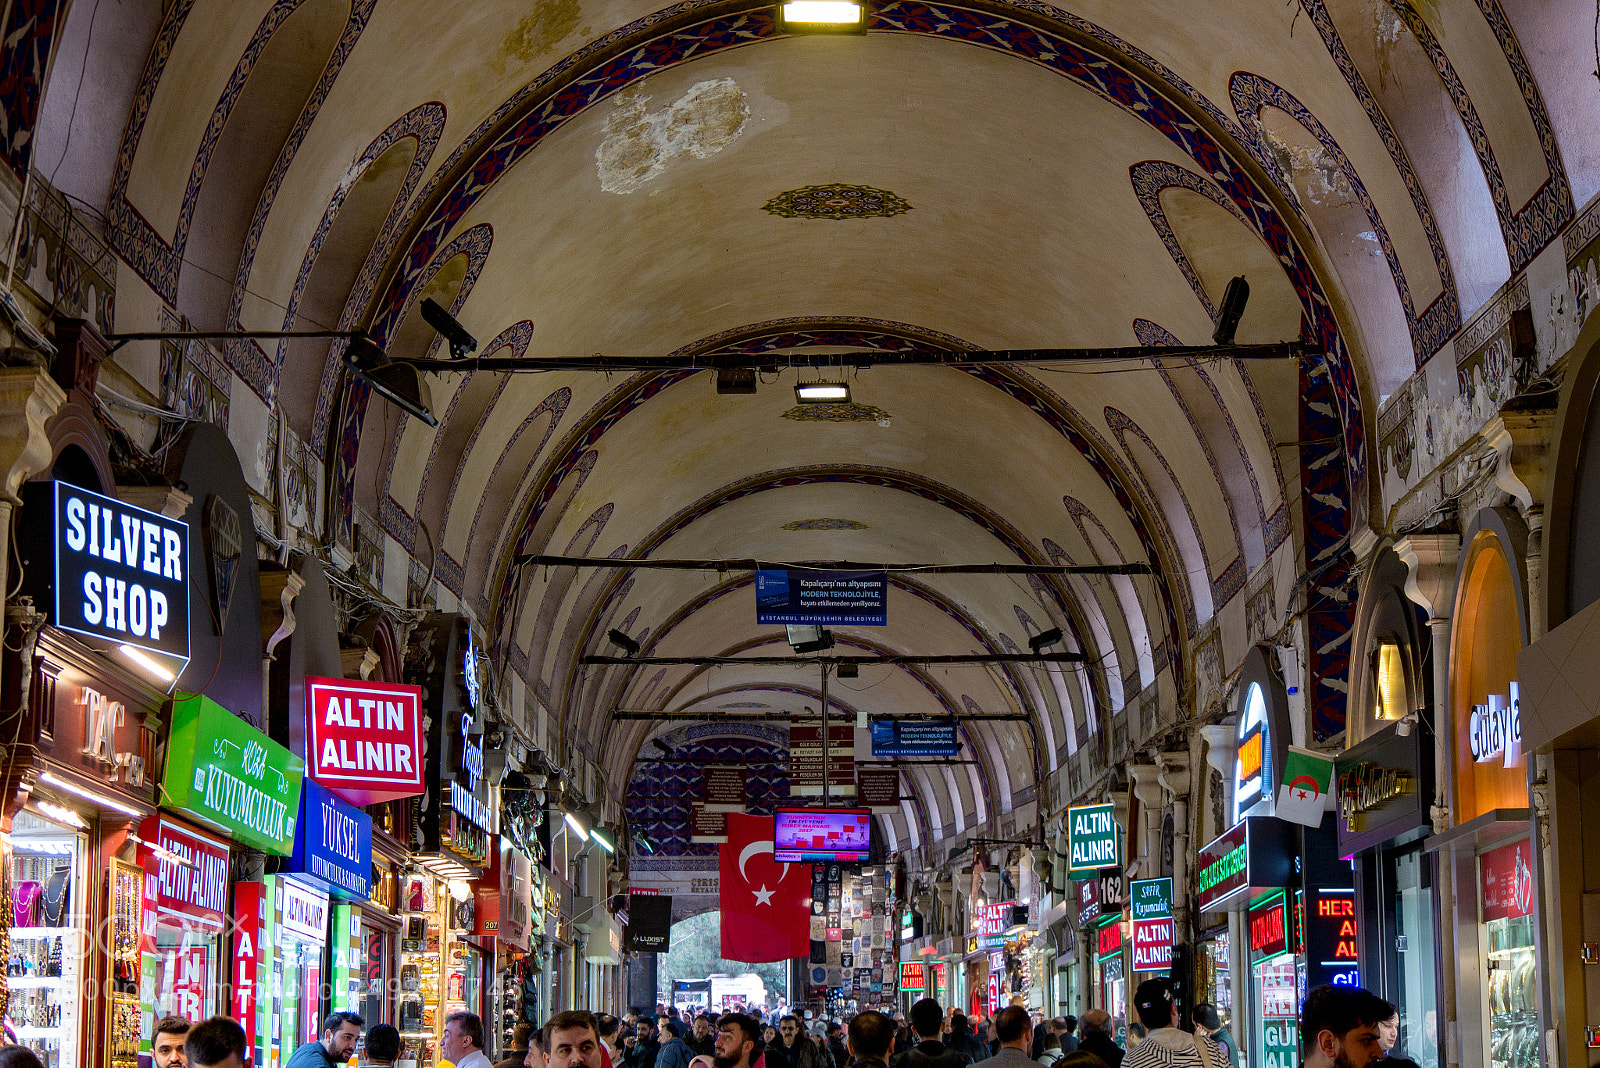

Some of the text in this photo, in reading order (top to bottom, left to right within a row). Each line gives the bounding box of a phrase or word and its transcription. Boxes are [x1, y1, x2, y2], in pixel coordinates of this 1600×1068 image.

[66, 497, 182, 582] SILVER
[83, 570, 169, 641] SHOP
[800, 590, 829, 598] MODERN
[325, 696, 404, 732] ALTIN
[321, 738, 413, 773] ALINIR
[204, 763, 287, 842] KUYUMCULUK
[321, 797, 360, 864] YÜKSEL
[1074, 811, 1111, 836] ALTIN
[1072, 839, 1115, 864] ALINIR
[190, 848, 227, 914] ALINIR
[1100, 876, 1122, 905] 162
[287, 895, 305, 924] ALTIN
[304, 900, 323, 931] ALINIR
[1318, 899, 1354, 916] HER
[485, 921, 498, 930] 207
[1136, 923, 1170, 943] ALTIN
[1134, 947, 1173, 965] ALINIR
